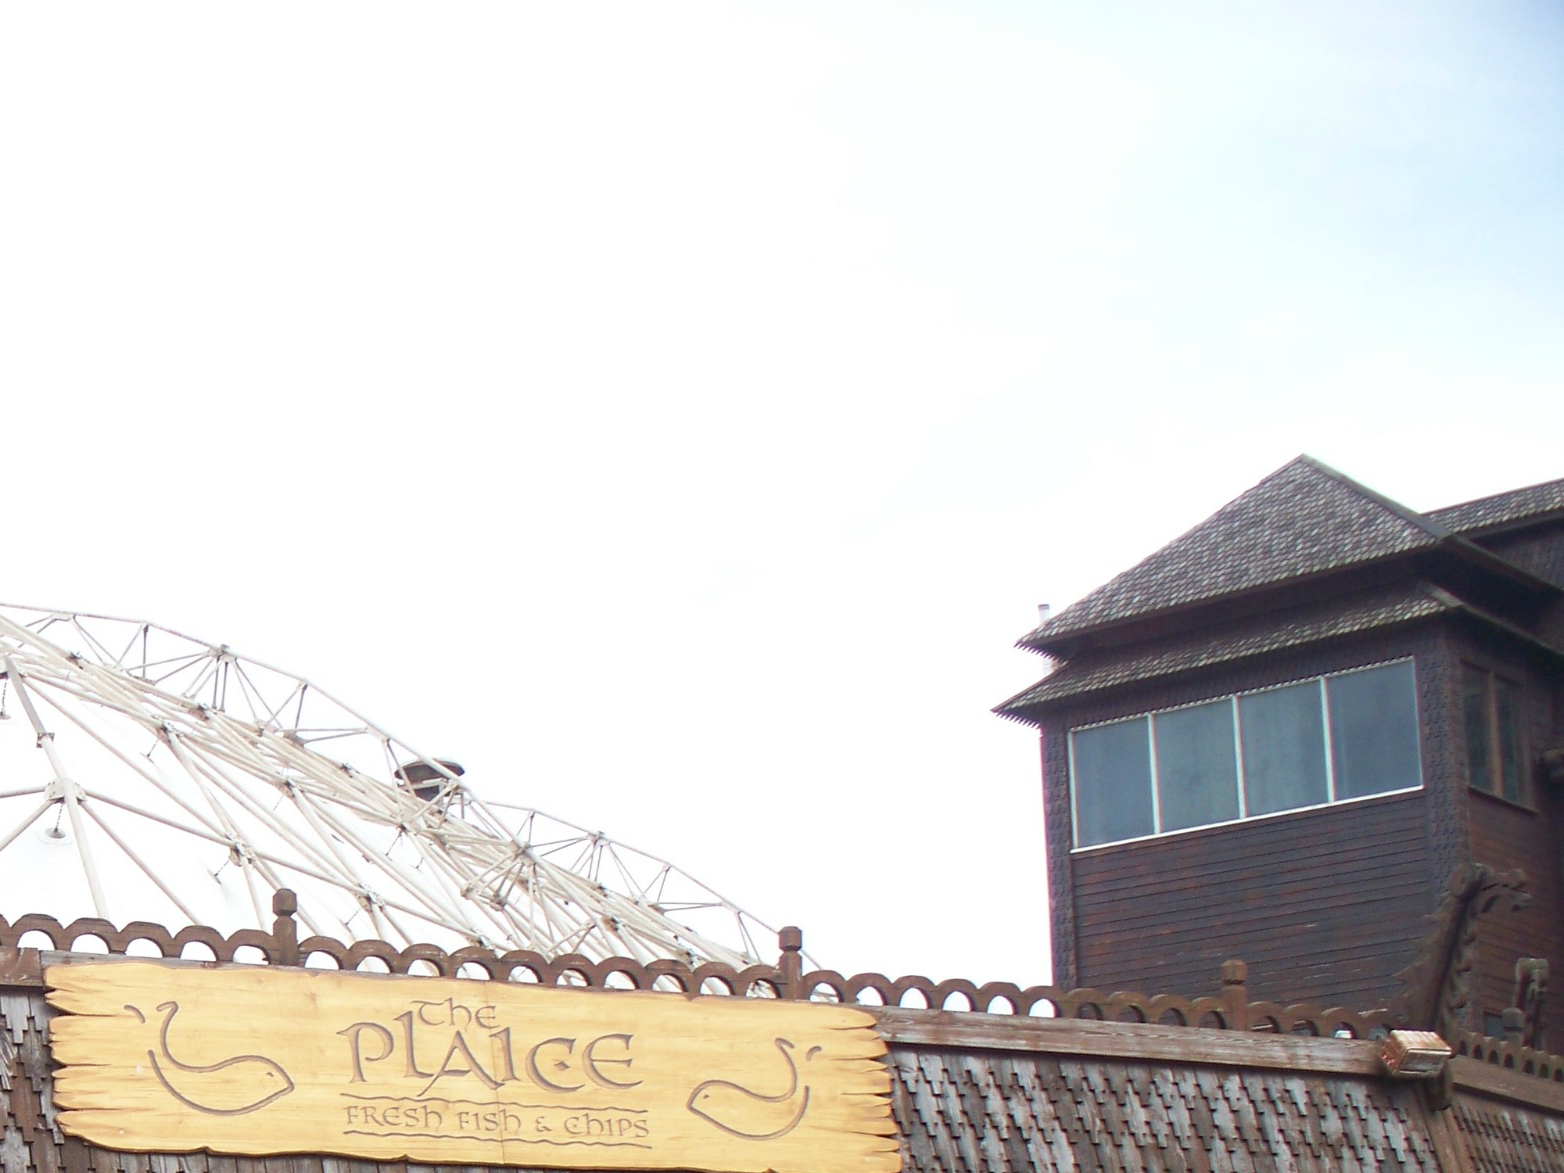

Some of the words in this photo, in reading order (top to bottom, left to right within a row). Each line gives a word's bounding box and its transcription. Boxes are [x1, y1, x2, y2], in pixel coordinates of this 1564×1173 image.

[336, 1010, 643, 1097] PLAICE
[535, 1116, 552, 1132] &
[564, 1113, 650, 1138] CHIPS
